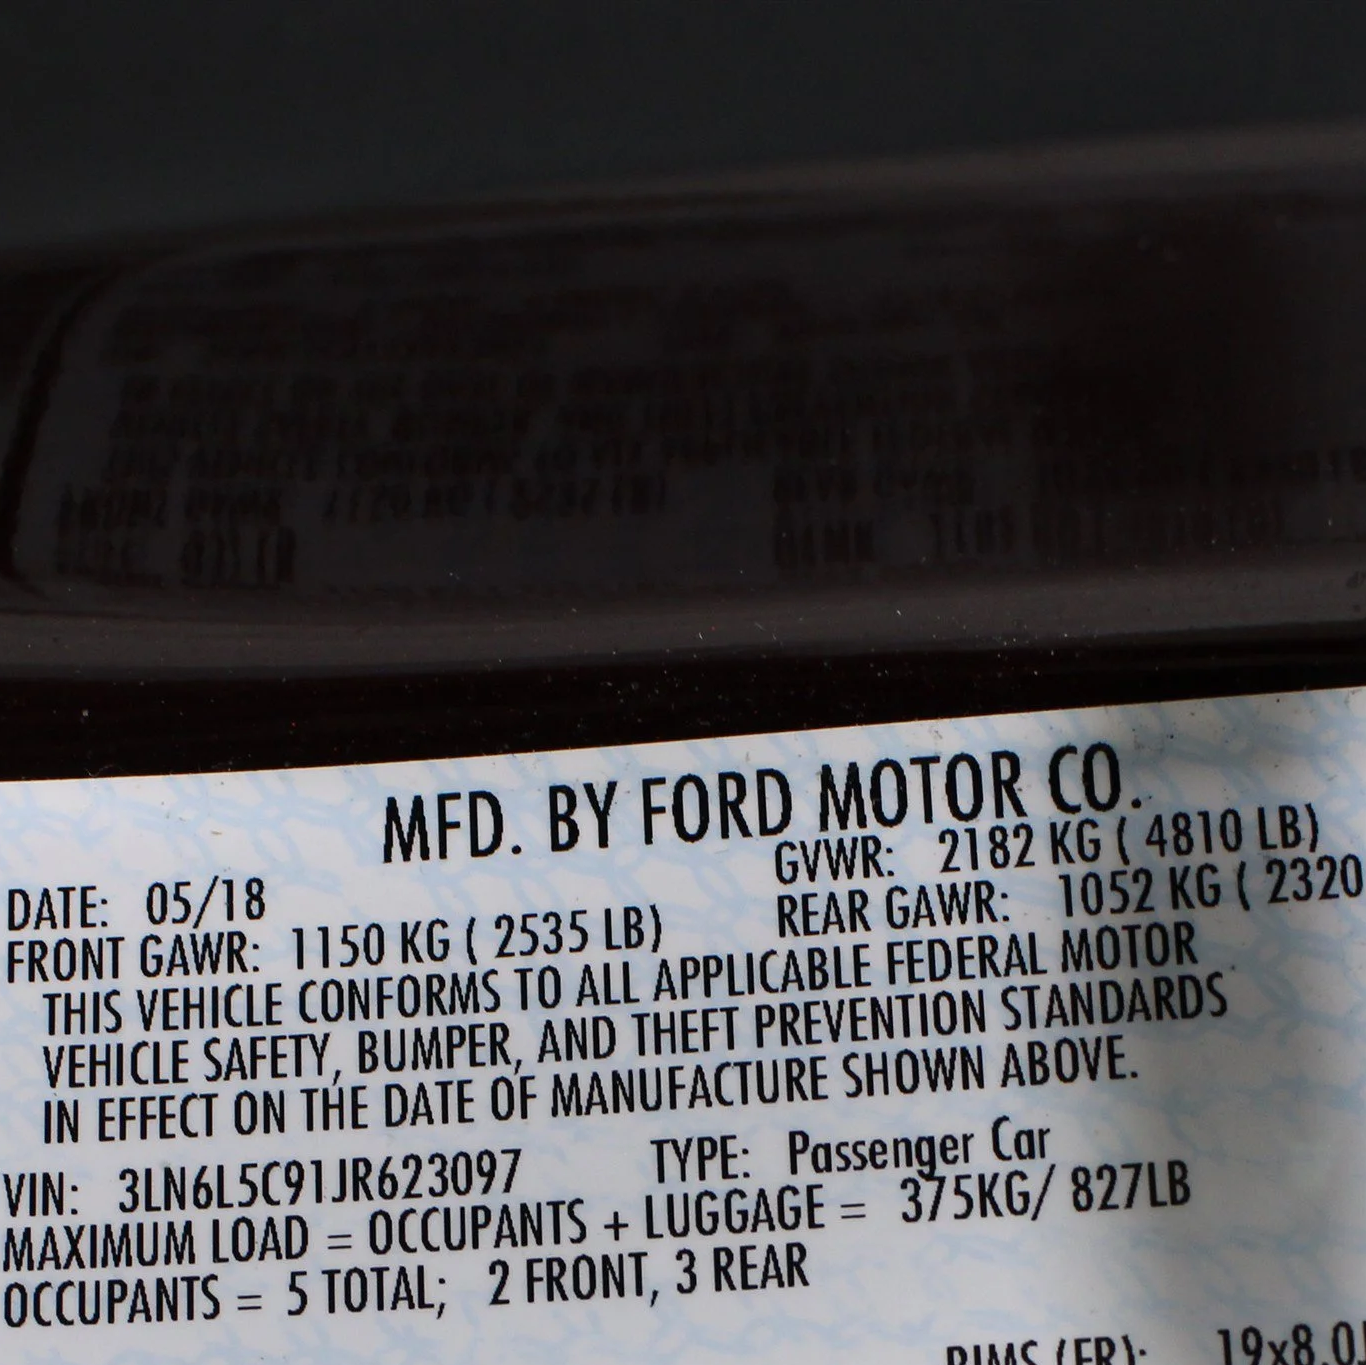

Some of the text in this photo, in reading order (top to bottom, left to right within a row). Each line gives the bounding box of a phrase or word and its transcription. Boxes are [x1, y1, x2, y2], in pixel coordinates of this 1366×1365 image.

[383, 742, 1142, 864] MFD. BY FORD MOTOR CO.
[775, 803, 1319, 885] GVWR: 2182 KG LB)
[8, 875, 265, 931] DATE: 05/18
[8, 904, 662, 983] FRONT GAWR: 1150 KG LB)
[777, 889, 871, 938] REAR
[885, 880, 1009, 929] GAWR:
[1059, 867, 1155, 917] 1052
[1169, 863, 1221, 910] KG
[43, 921, 1198, 1036] THIS VEHICLE CONFORMS TO ALL APPLICABLE FEDERAL MOTOR
[43, 971, 1227, 1089] VEHICLE SAFETY, BUMPER, AND THEFT PREVENTION STANDARDS
[44, 1035, 1138, 1144] IN EFFECT ON THE DATE OF MANUFACTURE SHOWN ABOVE.
[3, 1115, 1050, 1217] VIN: 3LN6L5C91JR623097 TYPE: Passenger Car
[3, 1220, 195, 1272] MAXIMUM
[212, 1215, 308, 1263] LOAD
[369, 1198, 586, 1255] OCCUPANTS
[645, 1184, 825, 1239] LUGGAGE
[4, 1242, 810, 1328] OCCUPANTS 5 TOTAL; 2 FRONT, 3 REAR
